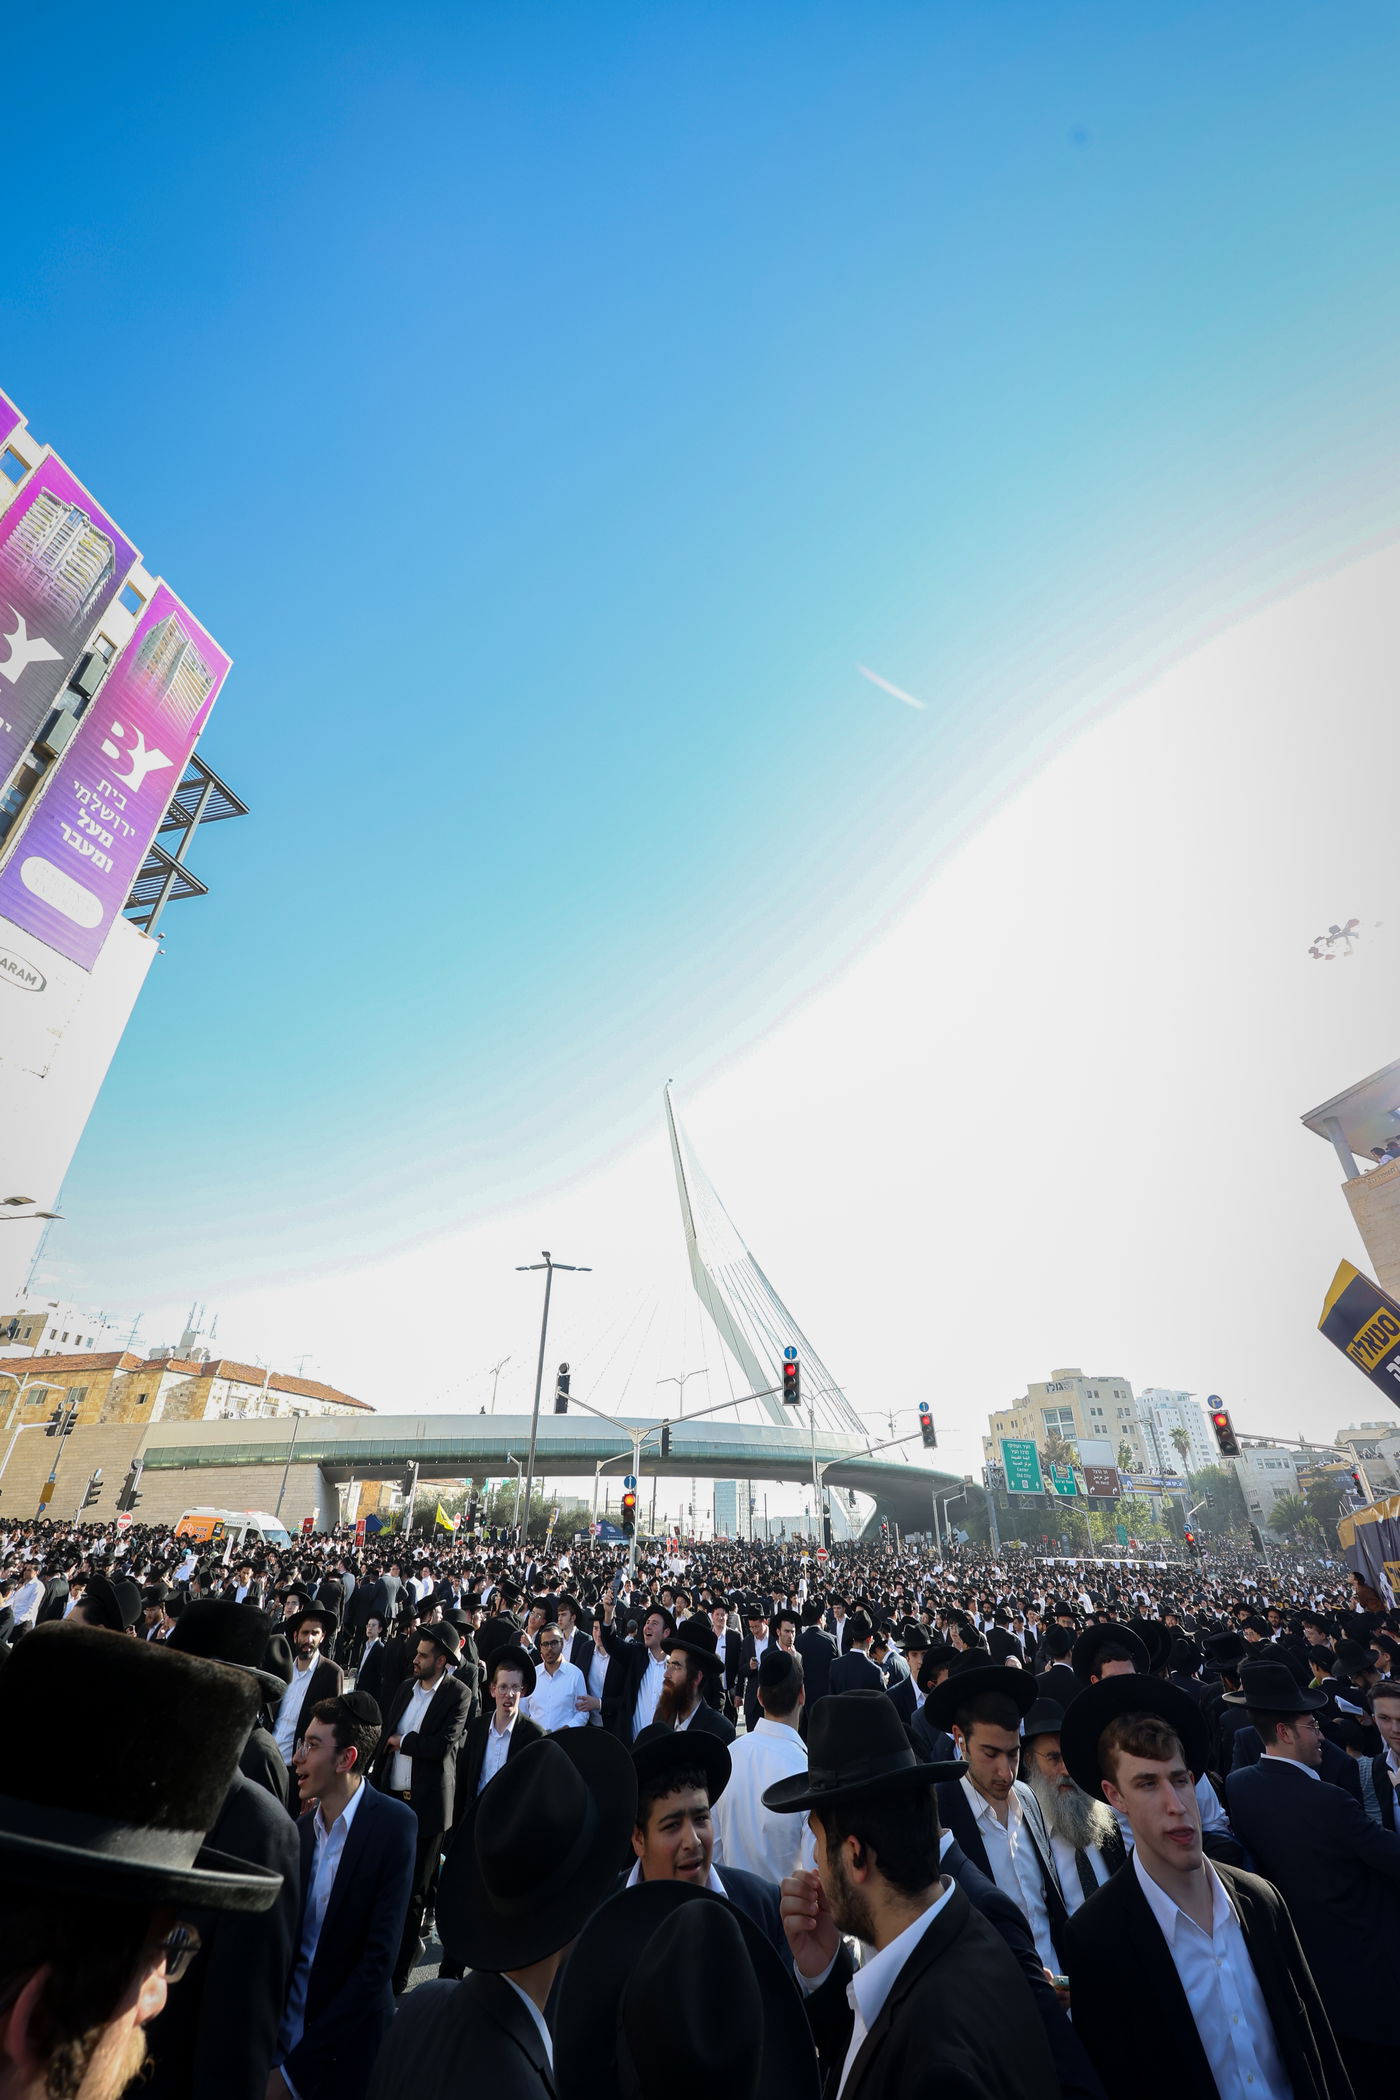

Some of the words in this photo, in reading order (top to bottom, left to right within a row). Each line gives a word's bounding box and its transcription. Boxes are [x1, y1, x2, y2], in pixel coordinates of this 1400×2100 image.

[101, 721, 174, 792] BY
[73, 780, 136, 837] ירושלמי
[96, 779, 128, 811] בית
[60, 822, 114, 873] ומעבר
[77, 807, 114, 848] מעל
